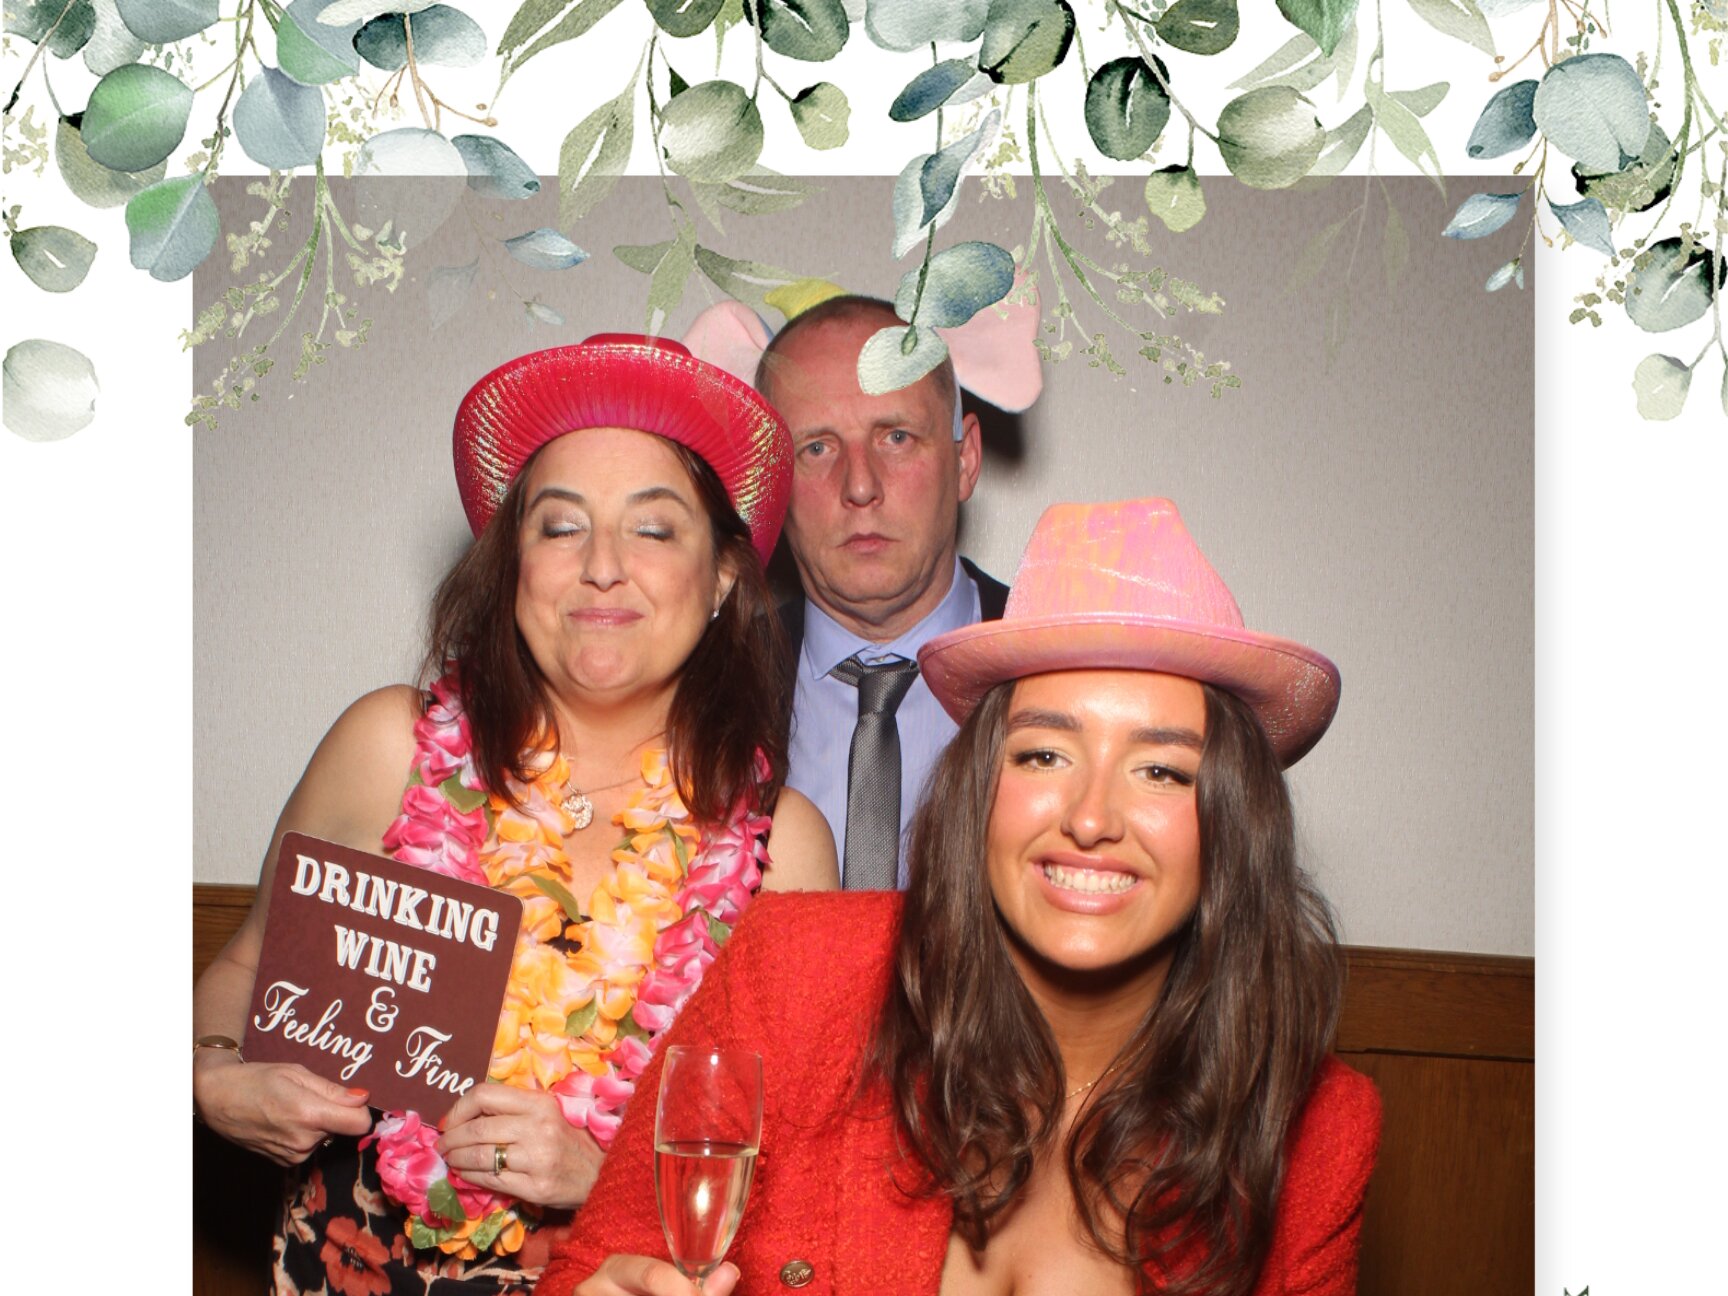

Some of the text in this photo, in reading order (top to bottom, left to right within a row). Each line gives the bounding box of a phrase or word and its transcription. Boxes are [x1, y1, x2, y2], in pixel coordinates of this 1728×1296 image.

[290, 854, 500, 952] DRINKING
[334, 924, 437, 993] WINE
[254, 980, 475, 1097] Feeling Fine
[365, 985, 400, 1033] &
